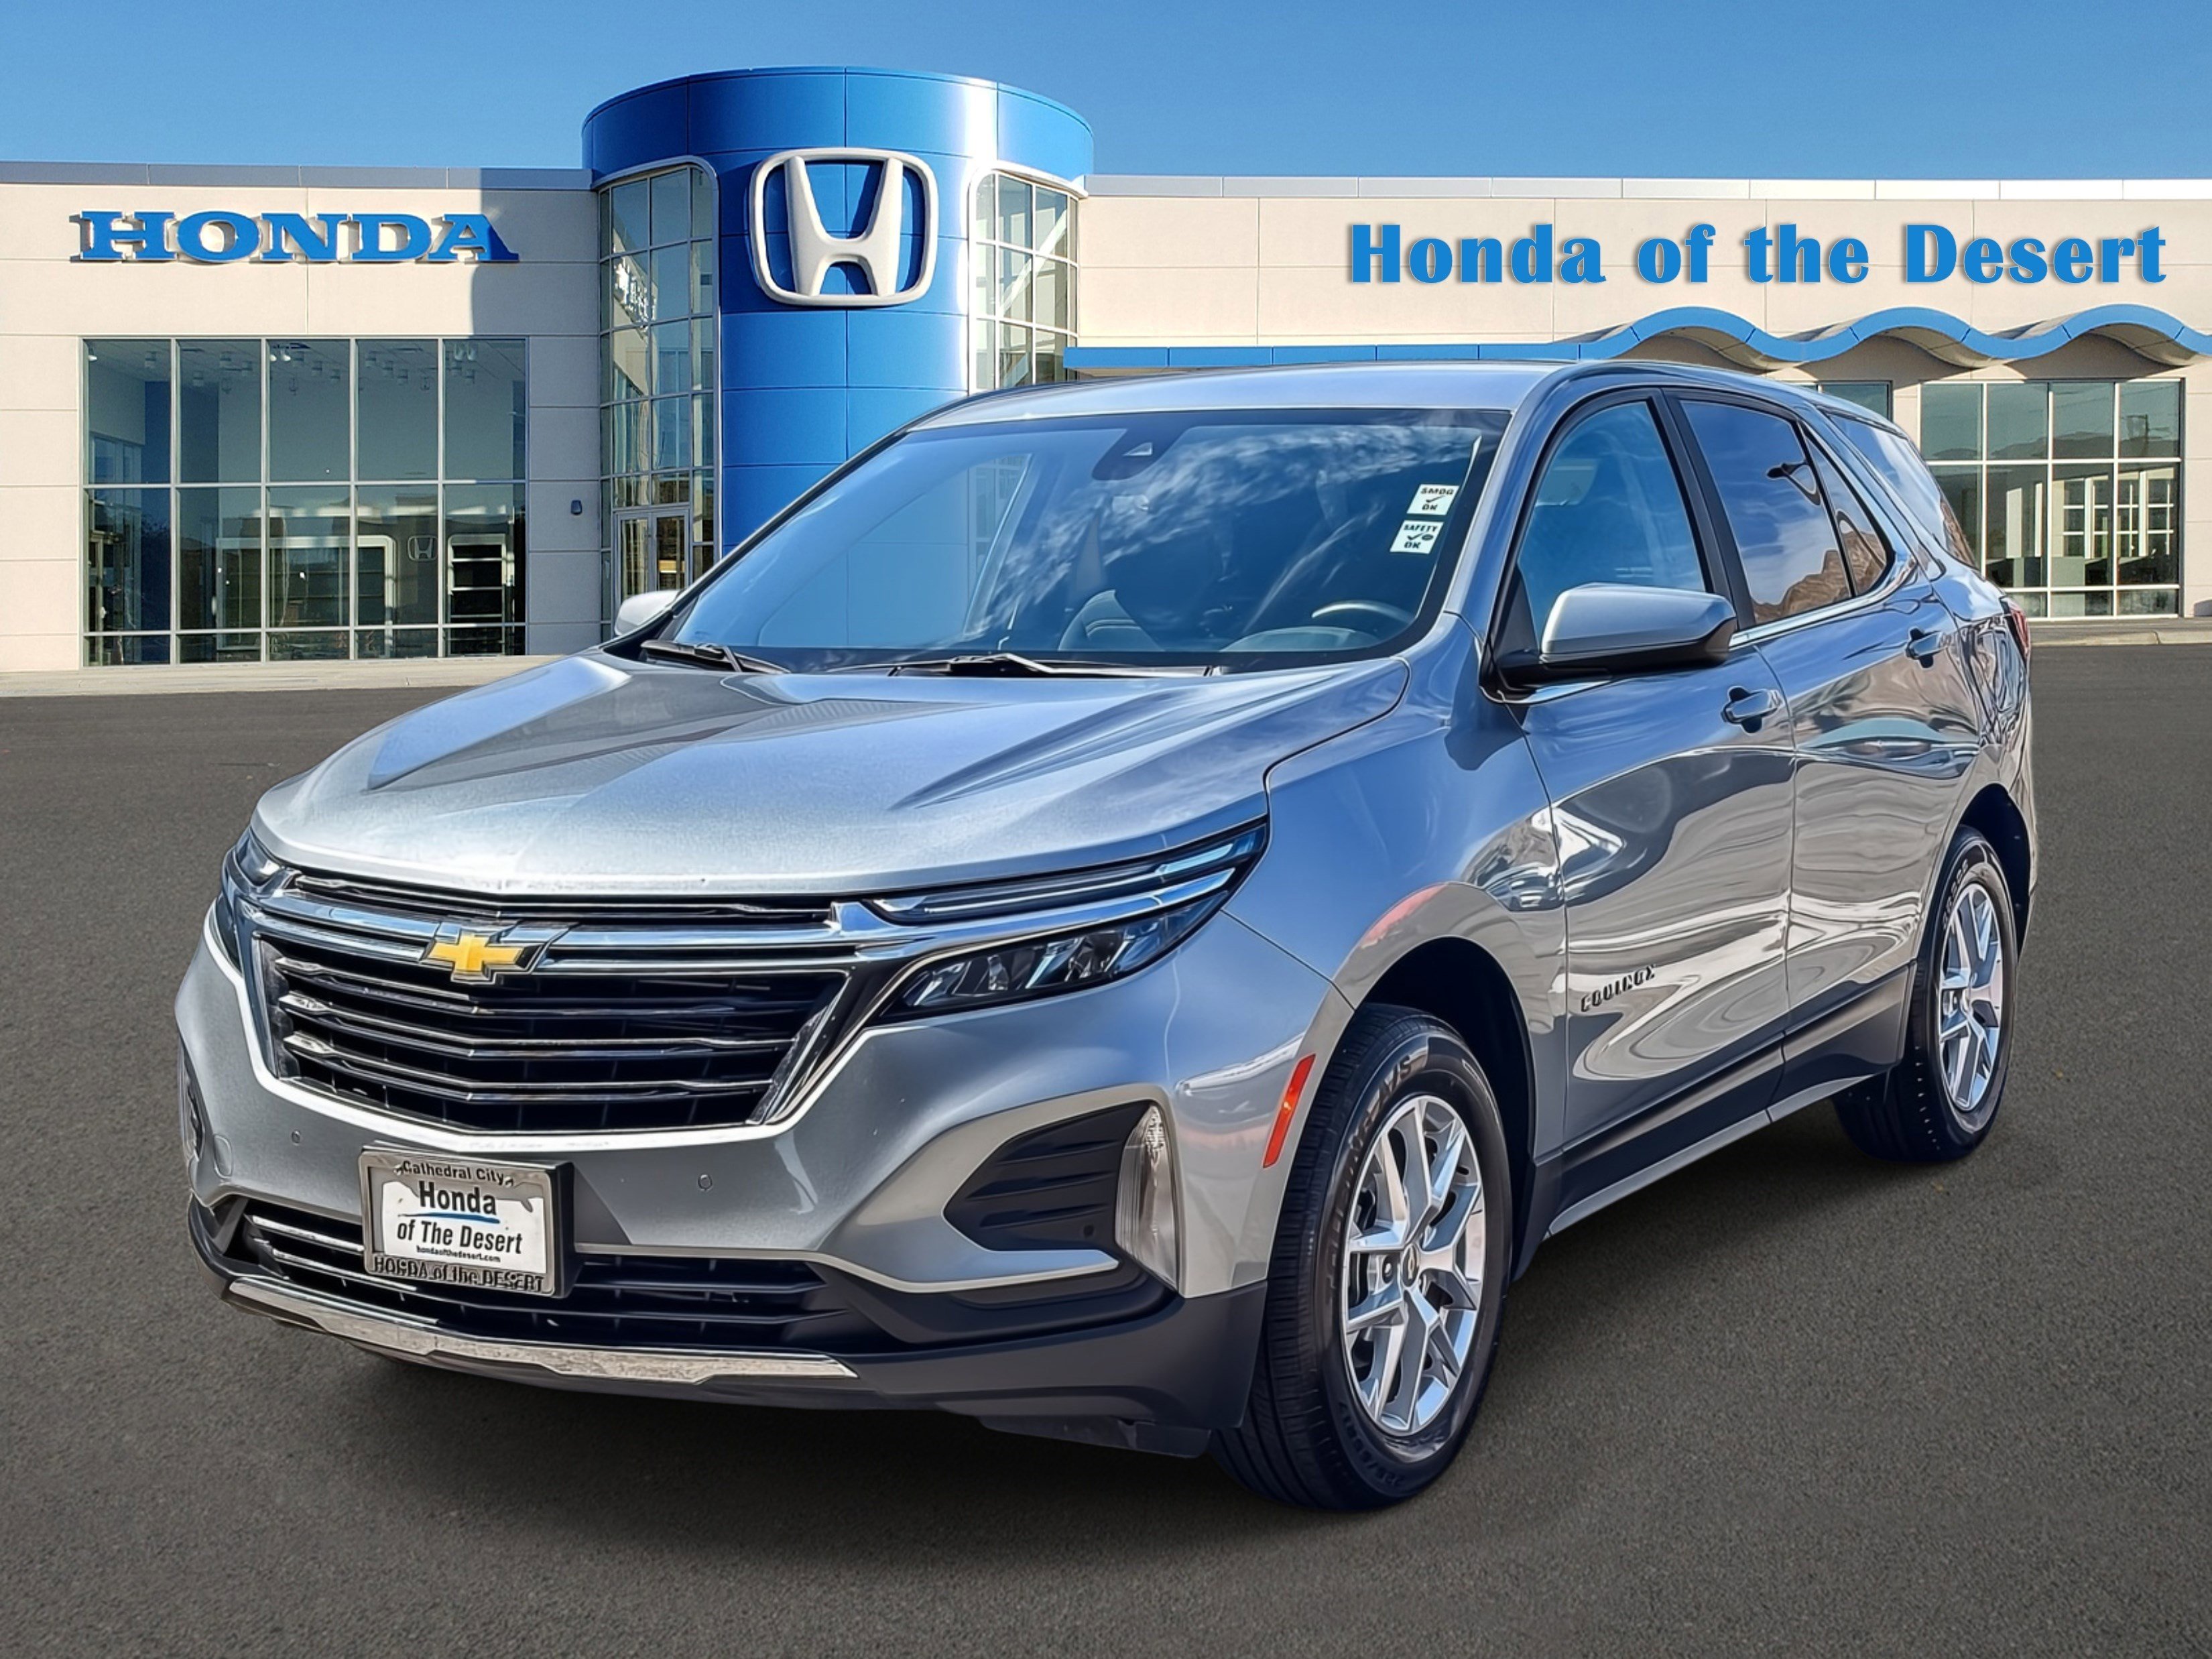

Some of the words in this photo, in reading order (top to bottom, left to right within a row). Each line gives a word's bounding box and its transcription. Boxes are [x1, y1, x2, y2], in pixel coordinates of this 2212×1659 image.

[80, 210, 519, 262] HONDA
[1351, 223, 1607, 284] Honda
[1638, 223, 1717, 284] of
[1744, 223, 1869, 284] the
[1906, 224, 2167, 284] Desert
[1404, 524, 1438, 532] SAFETY
[402, 1160, 472, 1180] Cathedral
[476, 1168, 505, 1186] City
[418, 1180, 497, 1216] Honda
[397, 1219, 416, 1241] of
[421, 1220, 453, 1246] The
[459, 1225, 523, 1255] Desert
[433, 1264, 448, 1281] of
[452, 1266, 477, 1285] the
